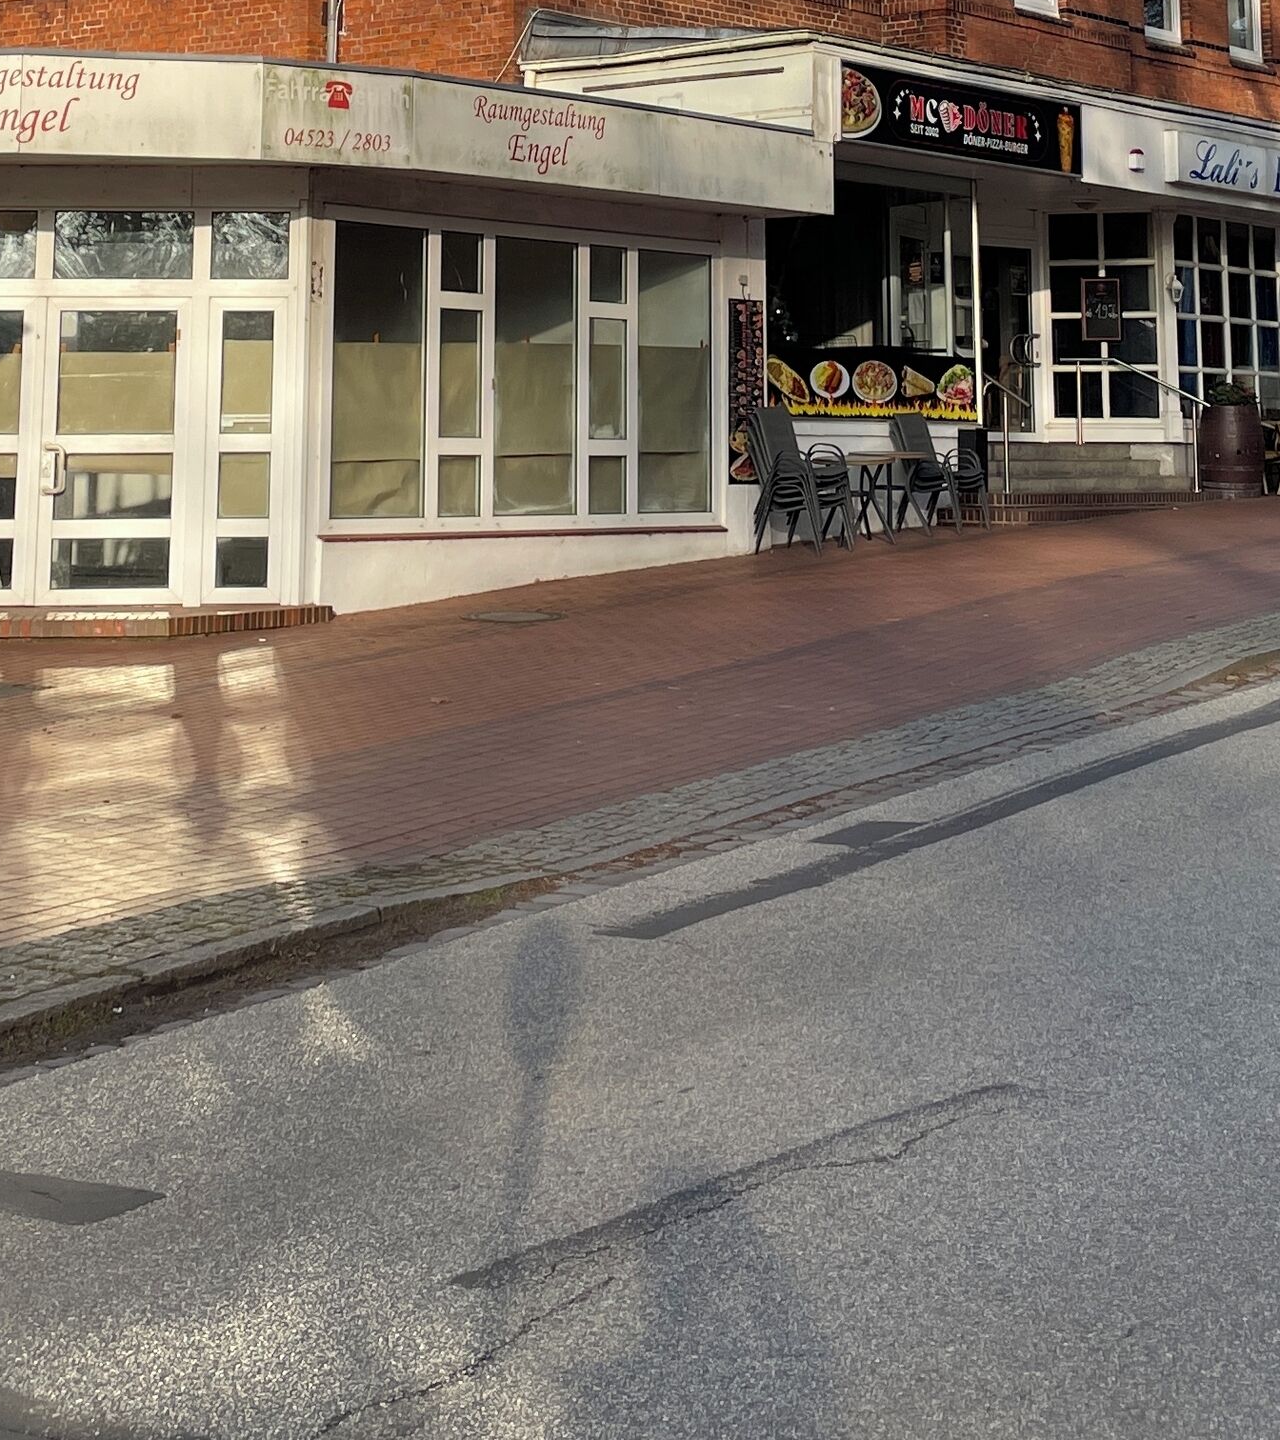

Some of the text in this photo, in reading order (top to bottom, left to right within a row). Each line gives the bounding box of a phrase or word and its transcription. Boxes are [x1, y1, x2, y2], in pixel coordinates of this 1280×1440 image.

[473, 95, 606, 140] Raumgestaltung
[910, 122, 925, 136] SEIT
[963, 101, 1029, 140] DÖNER
[284, 127, 335, 148] 04523
[352, 132, 391, 152] 2803
[508, 134, 573, 175] Engel
